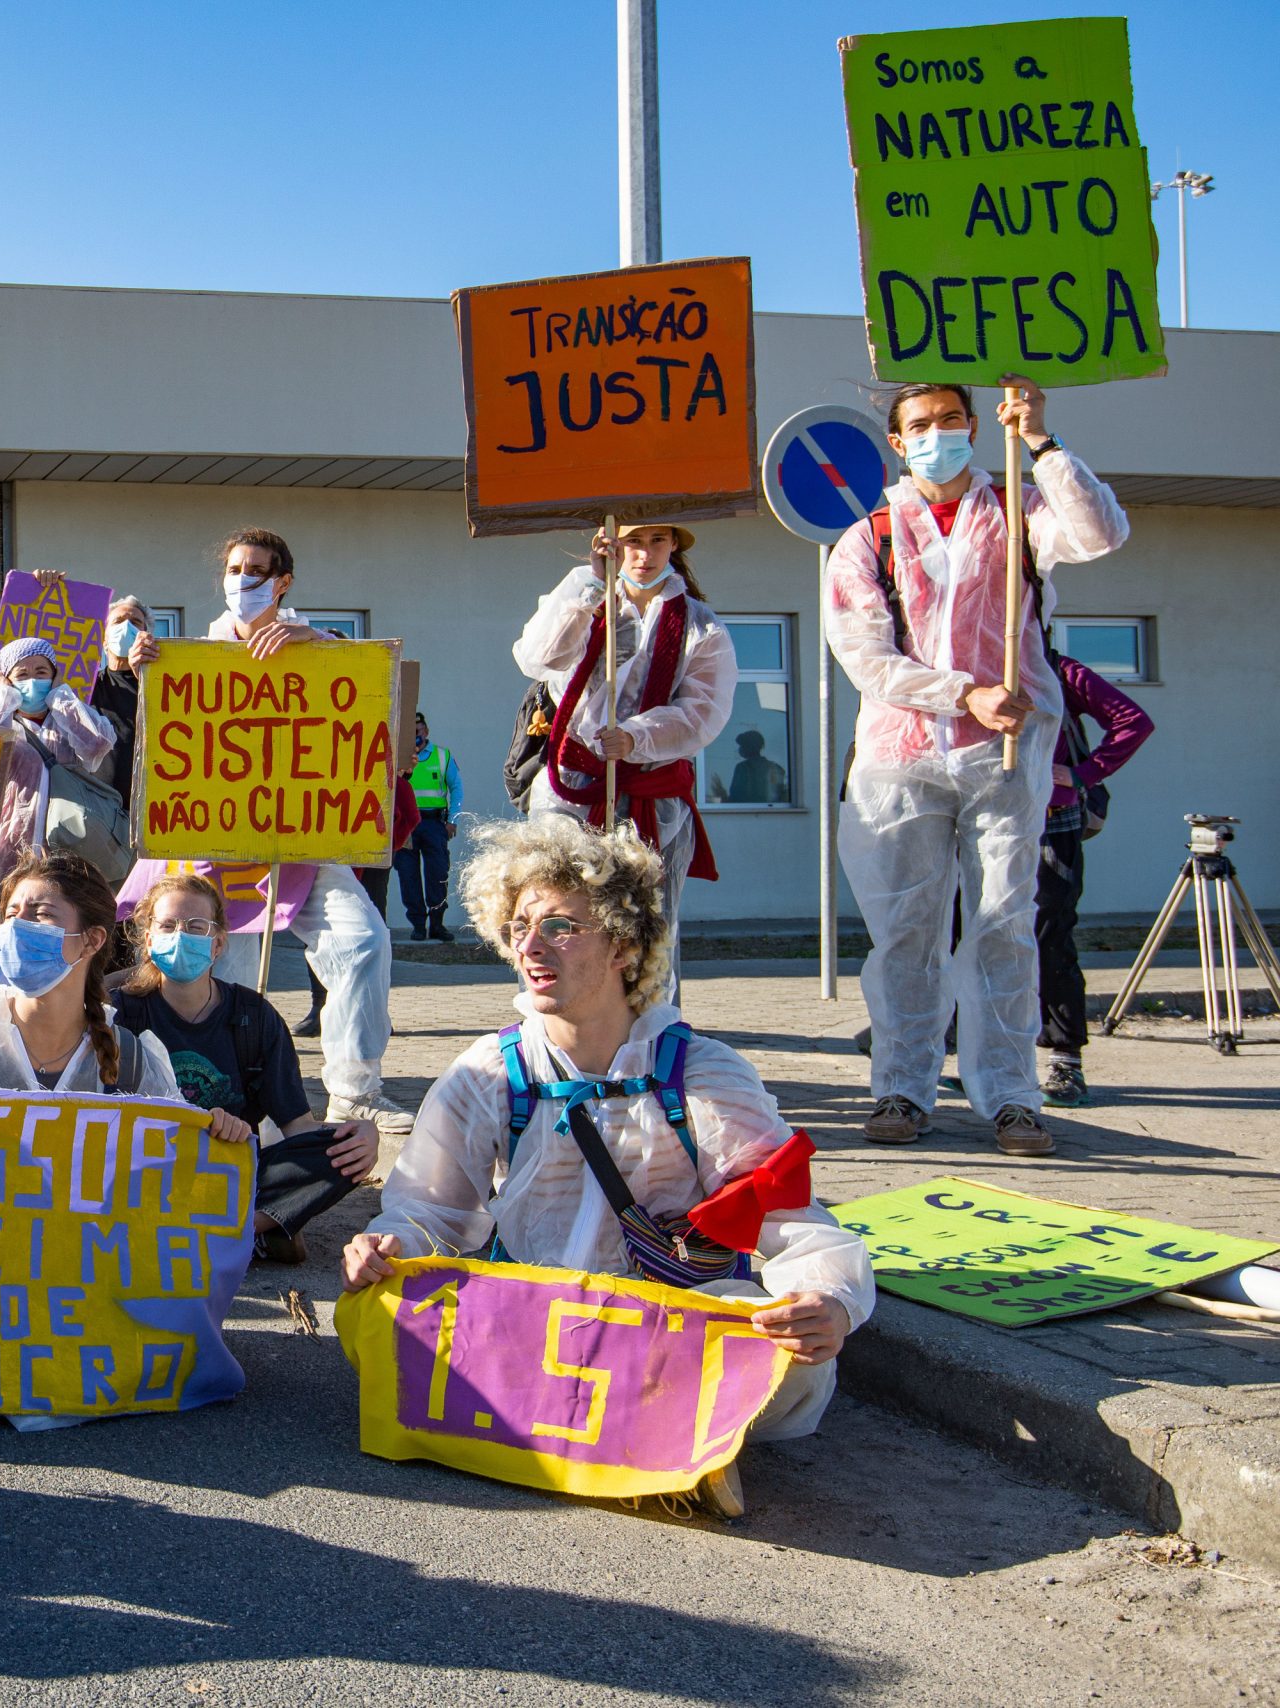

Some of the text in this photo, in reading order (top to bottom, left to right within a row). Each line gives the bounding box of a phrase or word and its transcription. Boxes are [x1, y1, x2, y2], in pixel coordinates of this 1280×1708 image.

[875, 53, 1048, 88] Somos a
[875, 100, 1131, 162] NATUREZA
[885, 177, 1118, 238] em AUTO
[878, 268, 1149, 364] DEFESA
[496, 352, 727, 453] JUSTA
[38, 583, 67, 619] A
[0, 604, 102, 658] NOSSA
[161, 671, 357, 715] MUDAR O
[154, 717, 394, 790] SISTEMA
[149, 785, 387, 835] NÃO O CLIMA
[0, 1285, 87, 1340] DE
